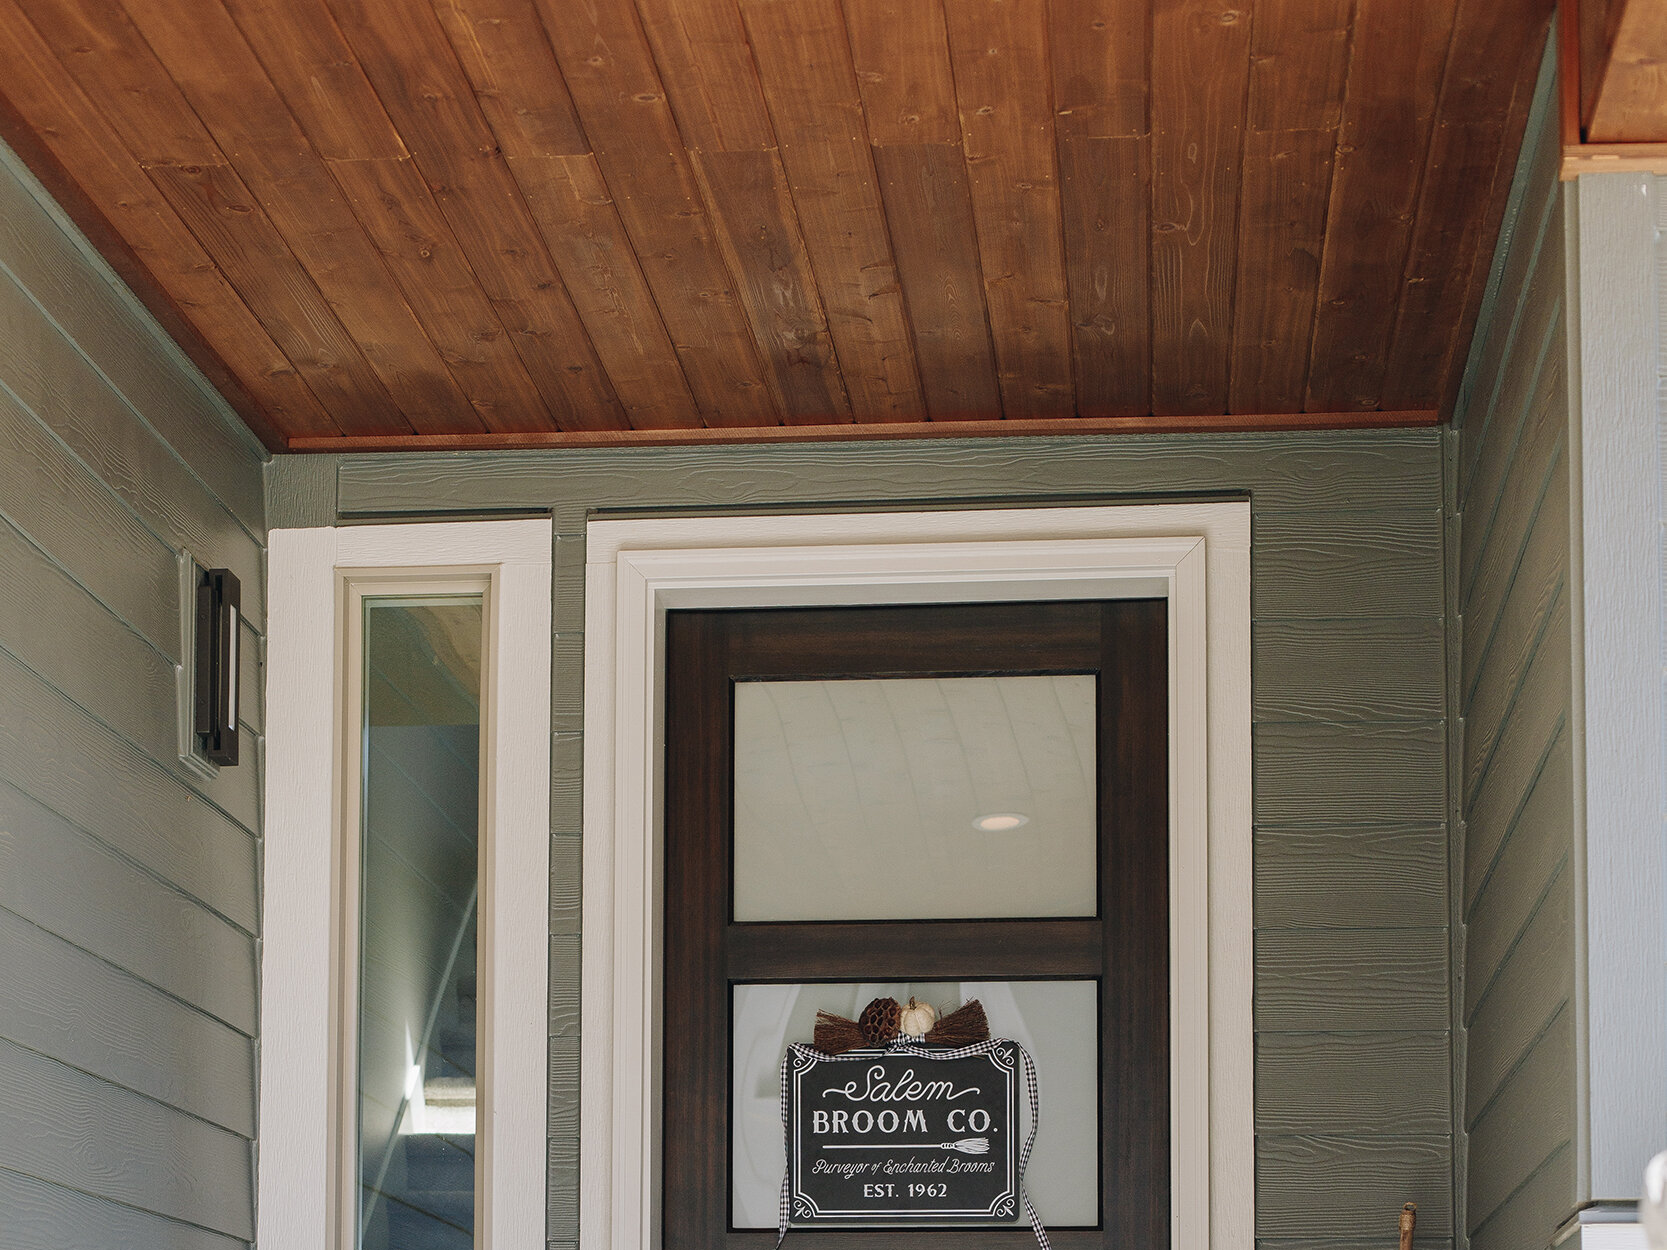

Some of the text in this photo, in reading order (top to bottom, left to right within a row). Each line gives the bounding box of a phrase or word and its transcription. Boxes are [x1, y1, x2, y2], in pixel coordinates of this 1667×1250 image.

[822, 1065, 981, 1102] Salem
[812, 1109, 999, 1134] BROOM CO.
[812, 1156, 995, 1180] Purveyor of Enchanted Brooms
[863, 1183, 947, 1198] EST. 1962
